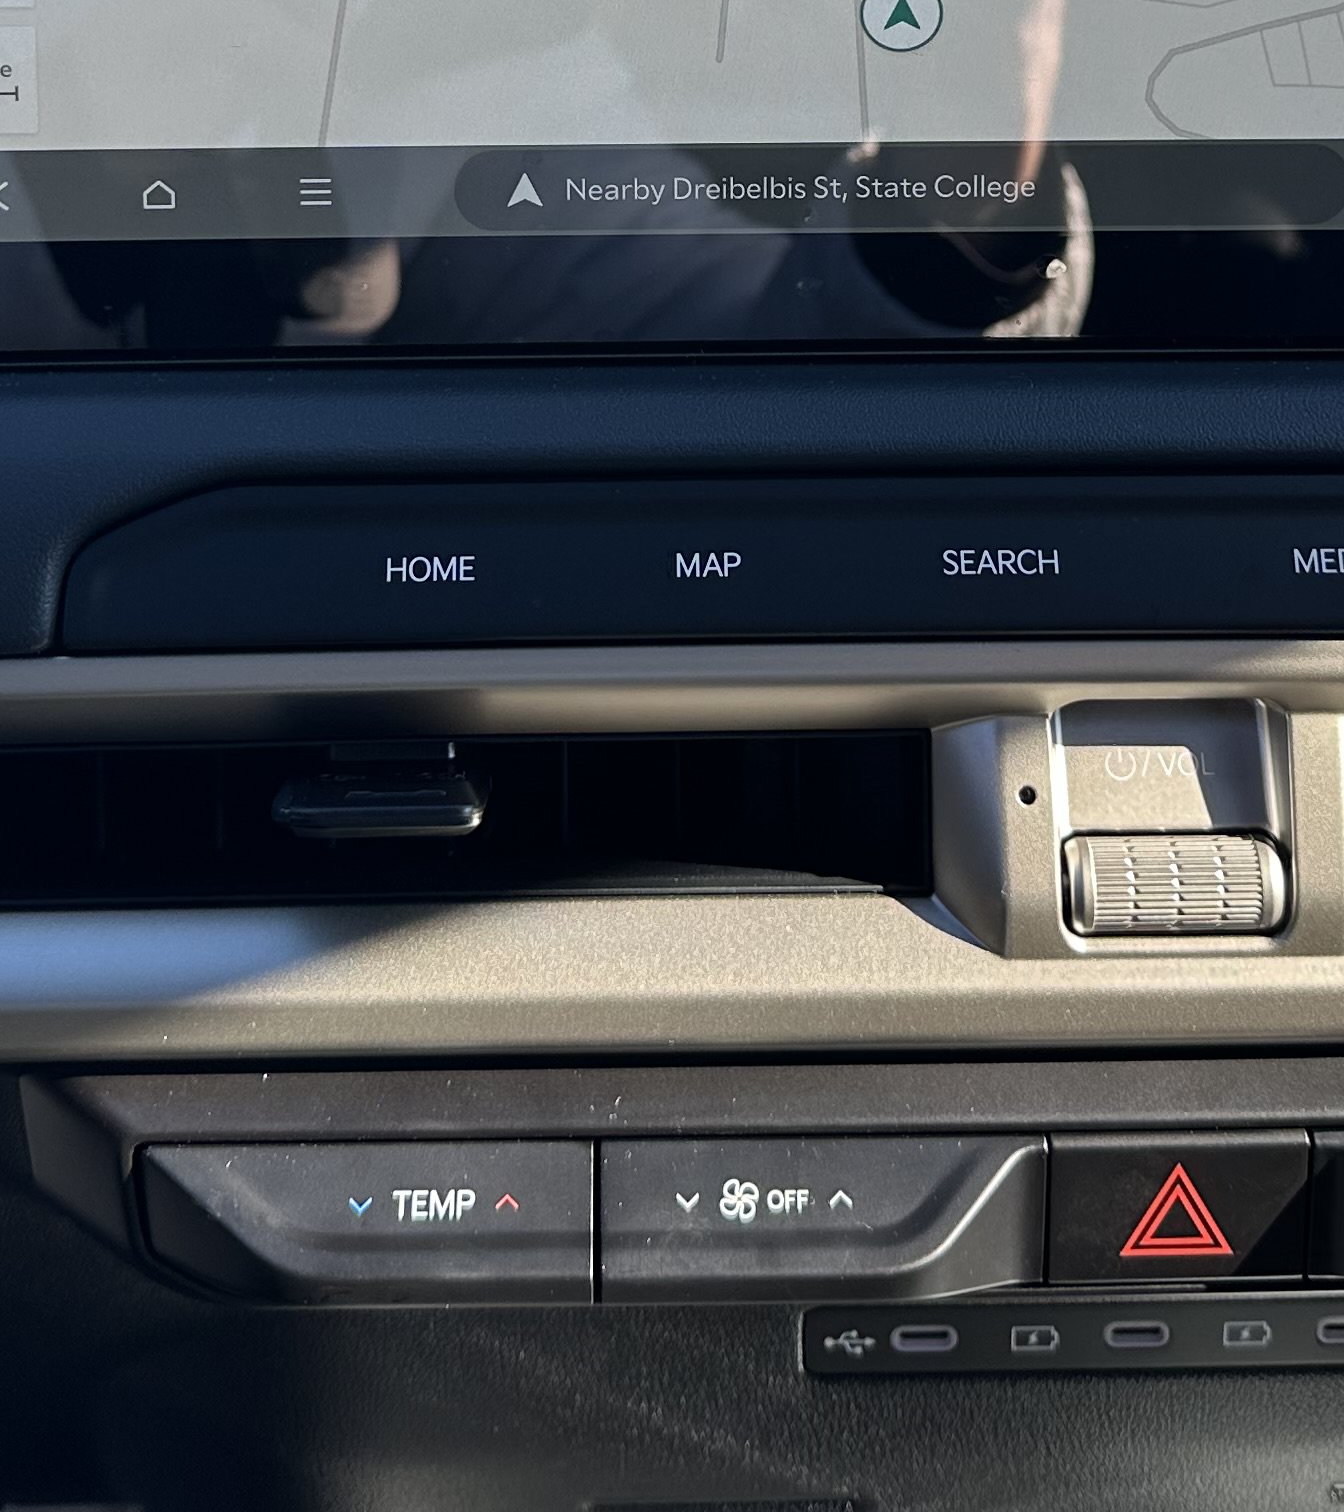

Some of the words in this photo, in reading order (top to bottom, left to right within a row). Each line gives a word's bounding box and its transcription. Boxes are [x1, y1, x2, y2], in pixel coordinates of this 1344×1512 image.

[565, 178, 667, 206] Nearby
[672, 175, 806, 201] Dreibelbis
[813, 177, 849, 204] St,
[856, 175, 928, 200] State
[934, 174, 1037, 205] College
[385, 554, 477, 584] HOME
[674, 551, 743, 579] MAP
[941, 548, 1061, 577] SEARCH
[392, 1189, 477, 1221] TEMP
[767, 1189, 809, 1213] OFF
